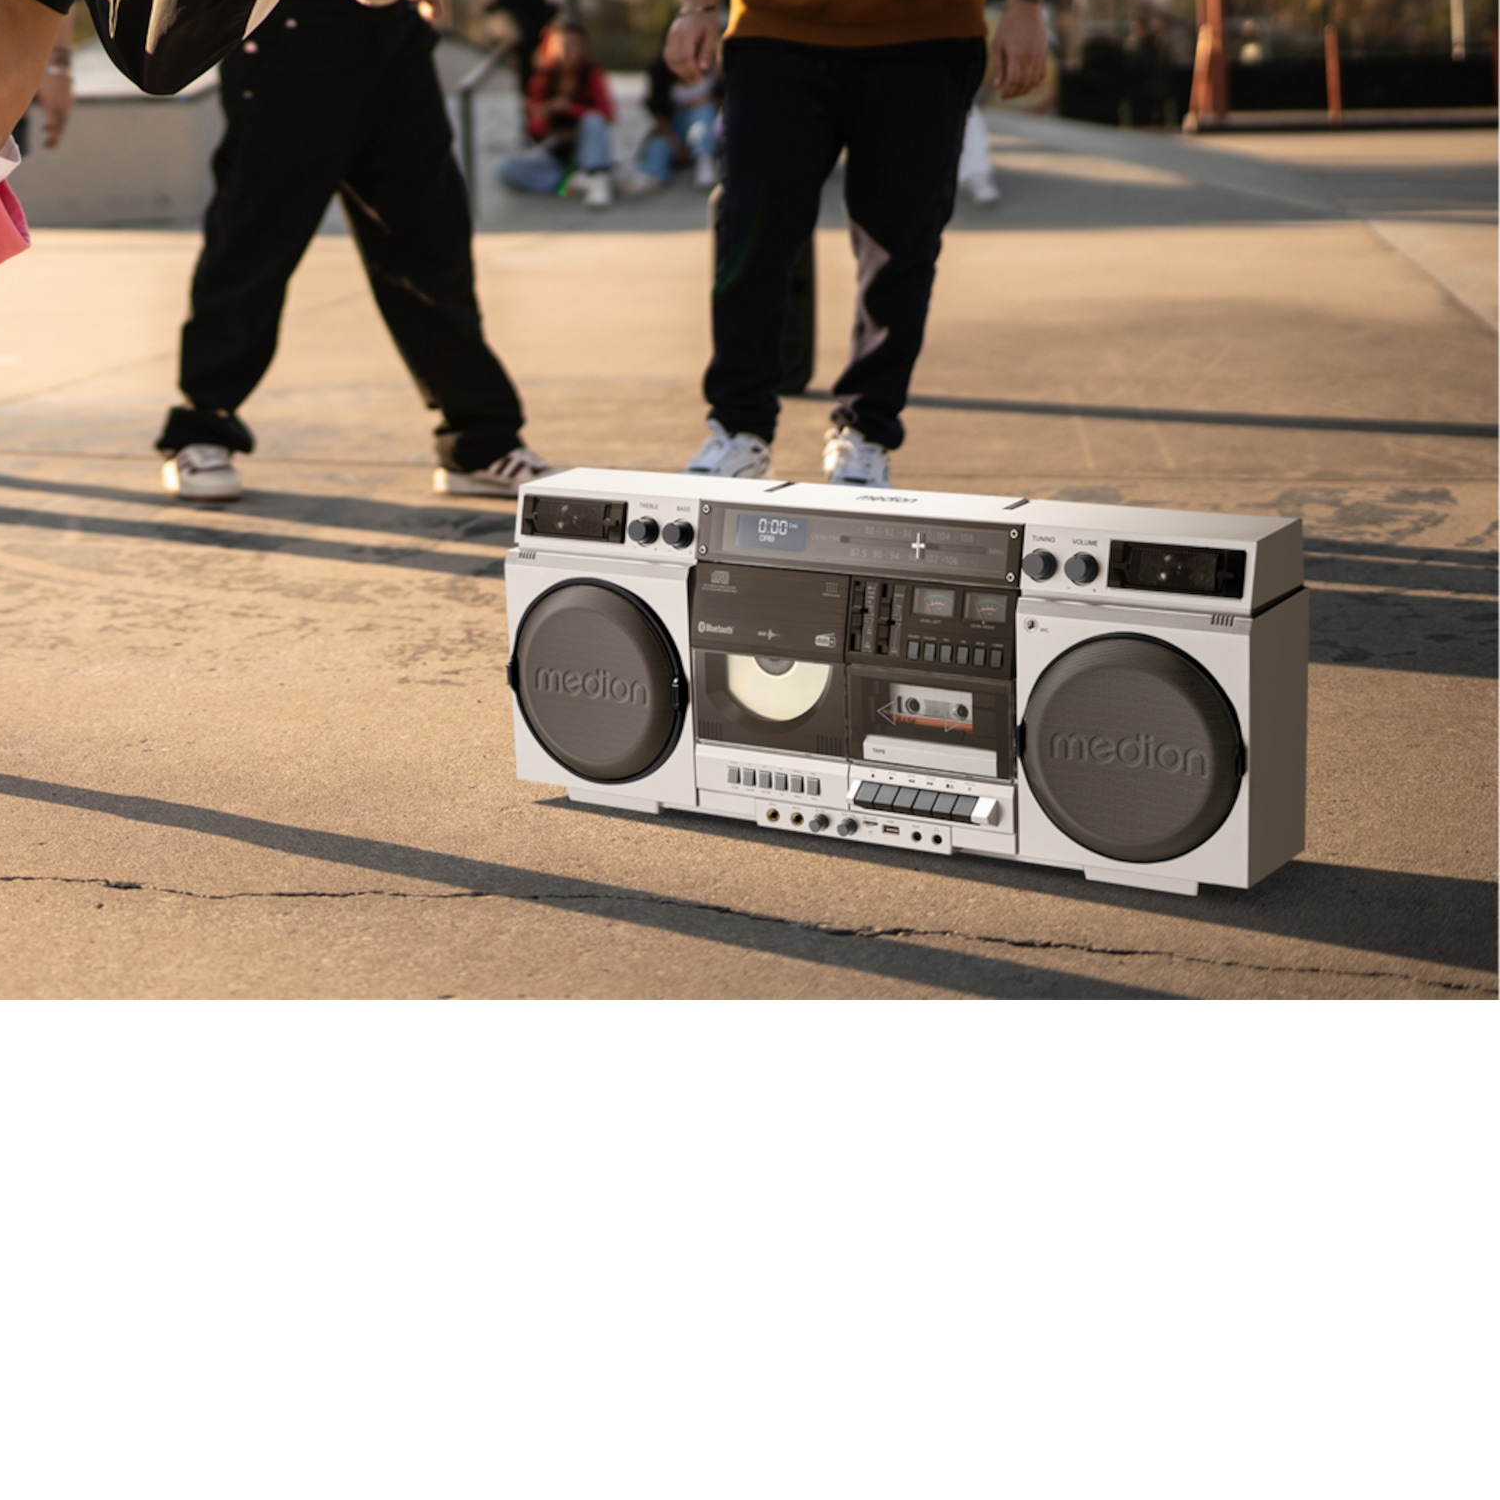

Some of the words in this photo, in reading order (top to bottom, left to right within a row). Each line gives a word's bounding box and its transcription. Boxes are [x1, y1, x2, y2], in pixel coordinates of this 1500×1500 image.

[856, 495, 918, 503] medion
[676, 505, 691, 513] BASS
[759, 518, 788, 535] 0:00
[1032, 534, 1056, 544] TUNING
[1071, 538, 1099, 547] VOLUME
[534, 666, 649, 707] medion
[1050, 731, 1209, 779] medion
